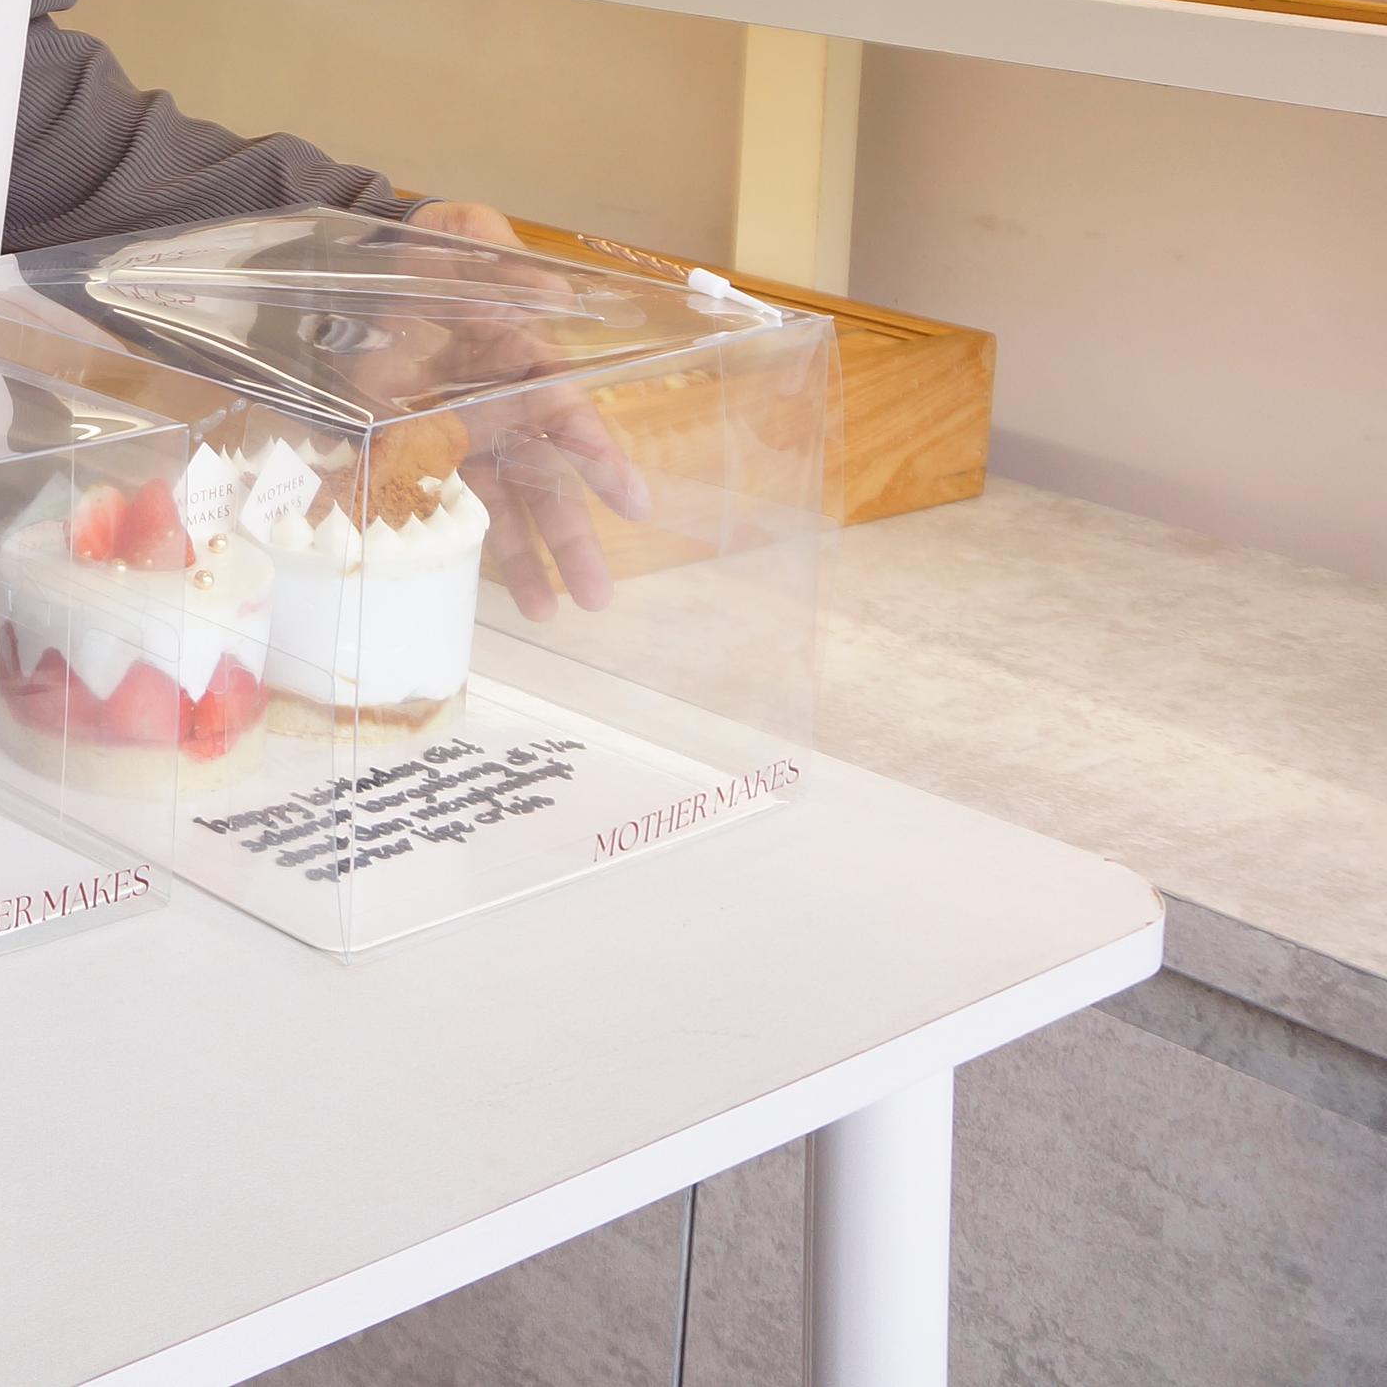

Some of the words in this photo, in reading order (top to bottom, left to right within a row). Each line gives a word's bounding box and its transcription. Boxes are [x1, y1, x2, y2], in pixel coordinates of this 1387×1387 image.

[256, 474, 306, 506] MOTHER
[187, 504, 232, 526] MAKES
[193, 801, 316, 835] happy
[593, 792, 708, 863] MOTHER
[713, 757, 801, 814] MAKES
[42, 863, 151, 922] MAKES
